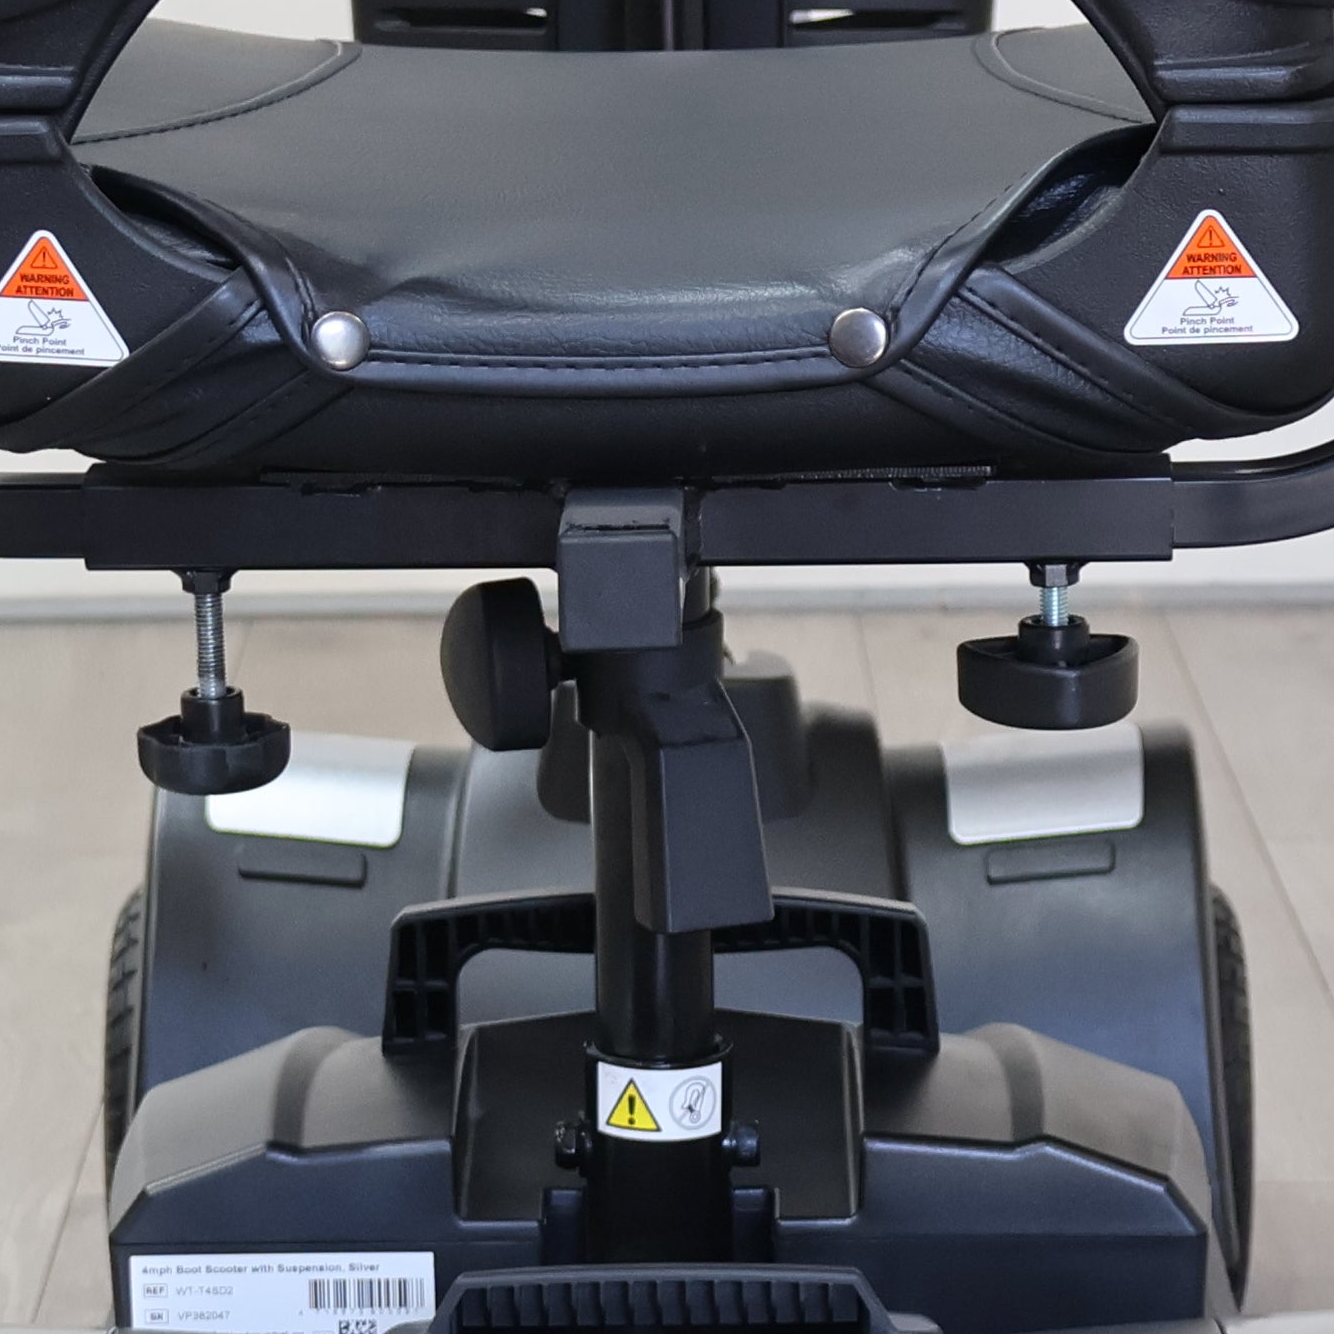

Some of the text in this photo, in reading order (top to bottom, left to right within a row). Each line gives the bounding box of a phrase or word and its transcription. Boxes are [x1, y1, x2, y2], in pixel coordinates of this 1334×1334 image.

[1186, 252, 1238, 263] WARNING
[1182, 264, 1242, 275] ATTENTION
[19, 273, 70, 285] WARNING
[15, 286, 74, 297] ATTENTION
[1180, 317, 1235, 326] Pinch Point
[1161, 325, 1254, 335] Point de pincement
[13, 336, 67, 346] Pinch Point
[22, 344, 33, 353] de
[36, 345, 86, 356] pincement
[141, 1265, 173, 1277] 4mph
[176, 1265, 202, 1274] Boot
[205, 1264, 248, 1273] Scooter
[251, 1263, 274, 1273] with
[348, 1262, 380, 1272] Silver
